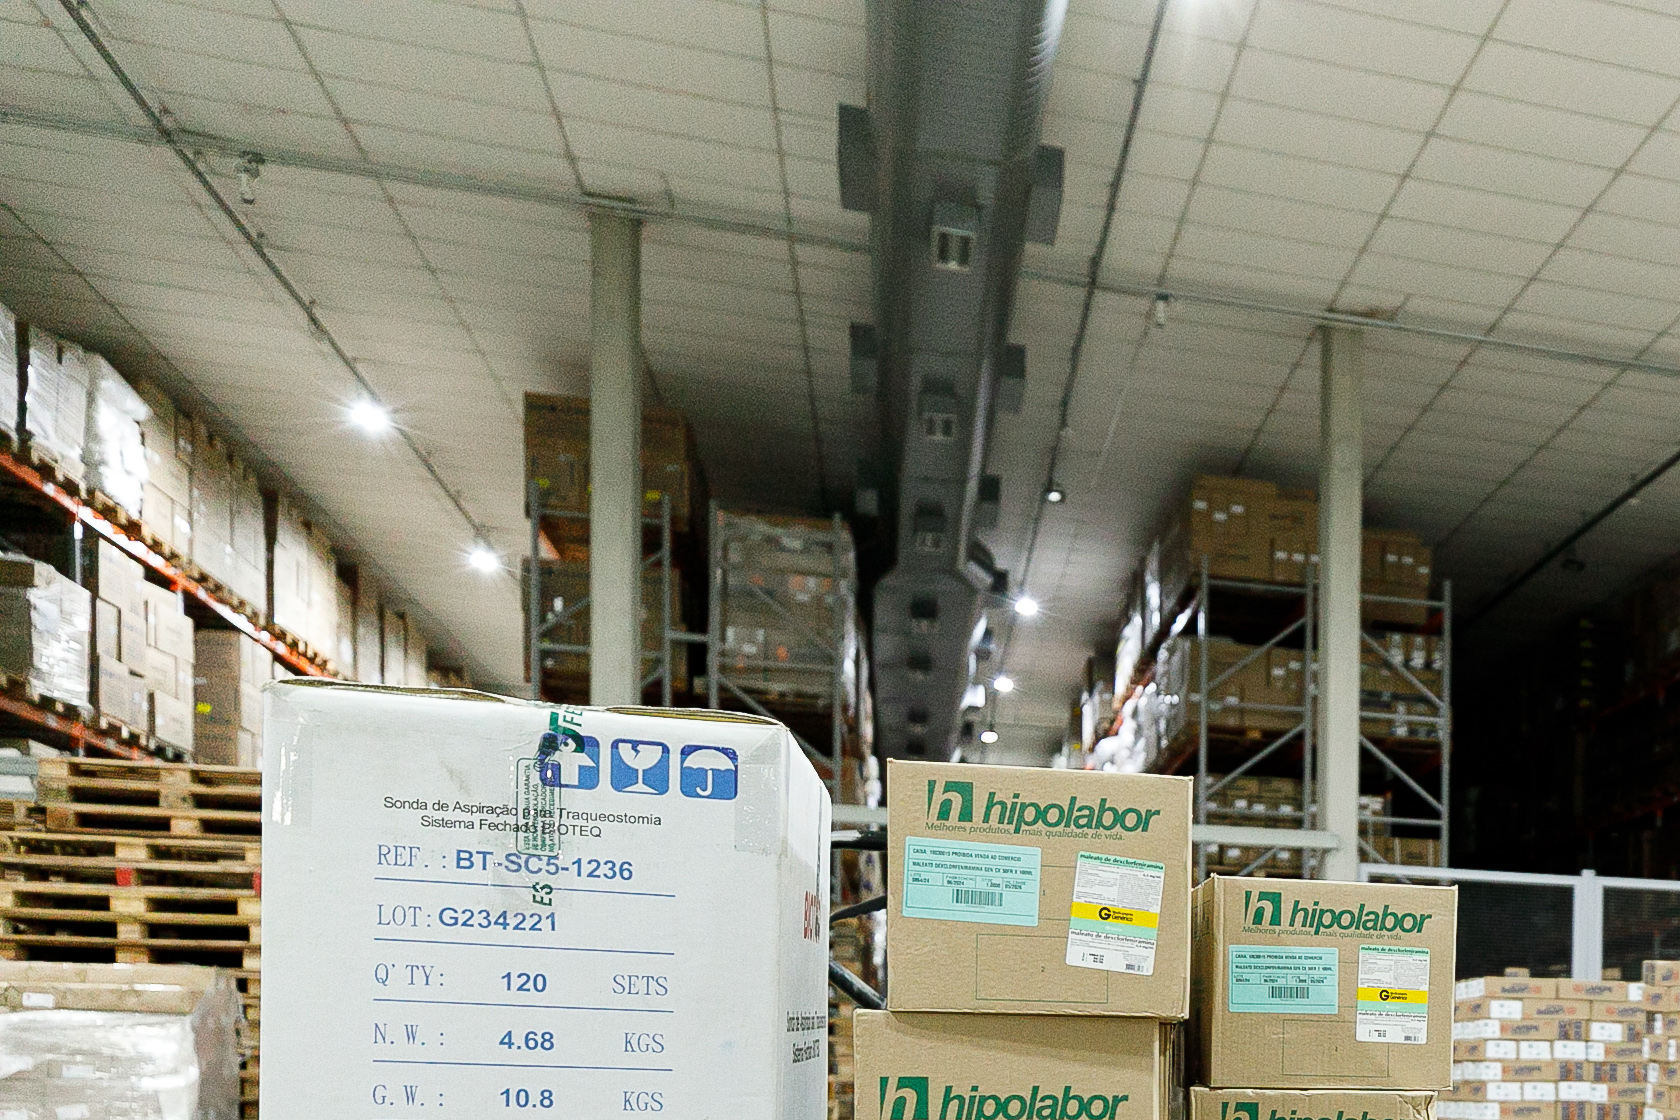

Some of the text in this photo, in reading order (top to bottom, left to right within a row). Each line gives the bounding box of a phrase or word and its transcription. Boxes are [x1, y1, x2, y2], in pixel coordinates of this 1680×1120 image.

[383, 796, 428, 812] Sonda
[432, 801, 450, 812] de
[452, 802, 518, 818] Aspiração
[558, 808, 662, 826] Traqueostomia
[983, 791, 1160, 834] hipolabor
[421, 816, 474, 830] Sistema
[479, 818, 536, 834] Fechado
[925, 822, 966, 834] Melhores
[969, 825, 1012, 836] produtos,
[1022, 828, 1043, 836] mais
[1046, 829, 1088, 840] qualidade
[1091, 832, 1102, 840] de
[455, 850, 633, 880] BT-SC5-1236
[438, 907, 556, 932] G234221
[1289, 900, 1432, 935] hipolabor
[500, 972, 548, 993] 120
[611, 975, 668, 997] SETS
[499, 1030, 555, 1050] 4.68
[623, 1033, 665, 1053] KGS
[499, 1089, 554, 1109] 10.8
[623, 1092, 664, 1112] KGS
